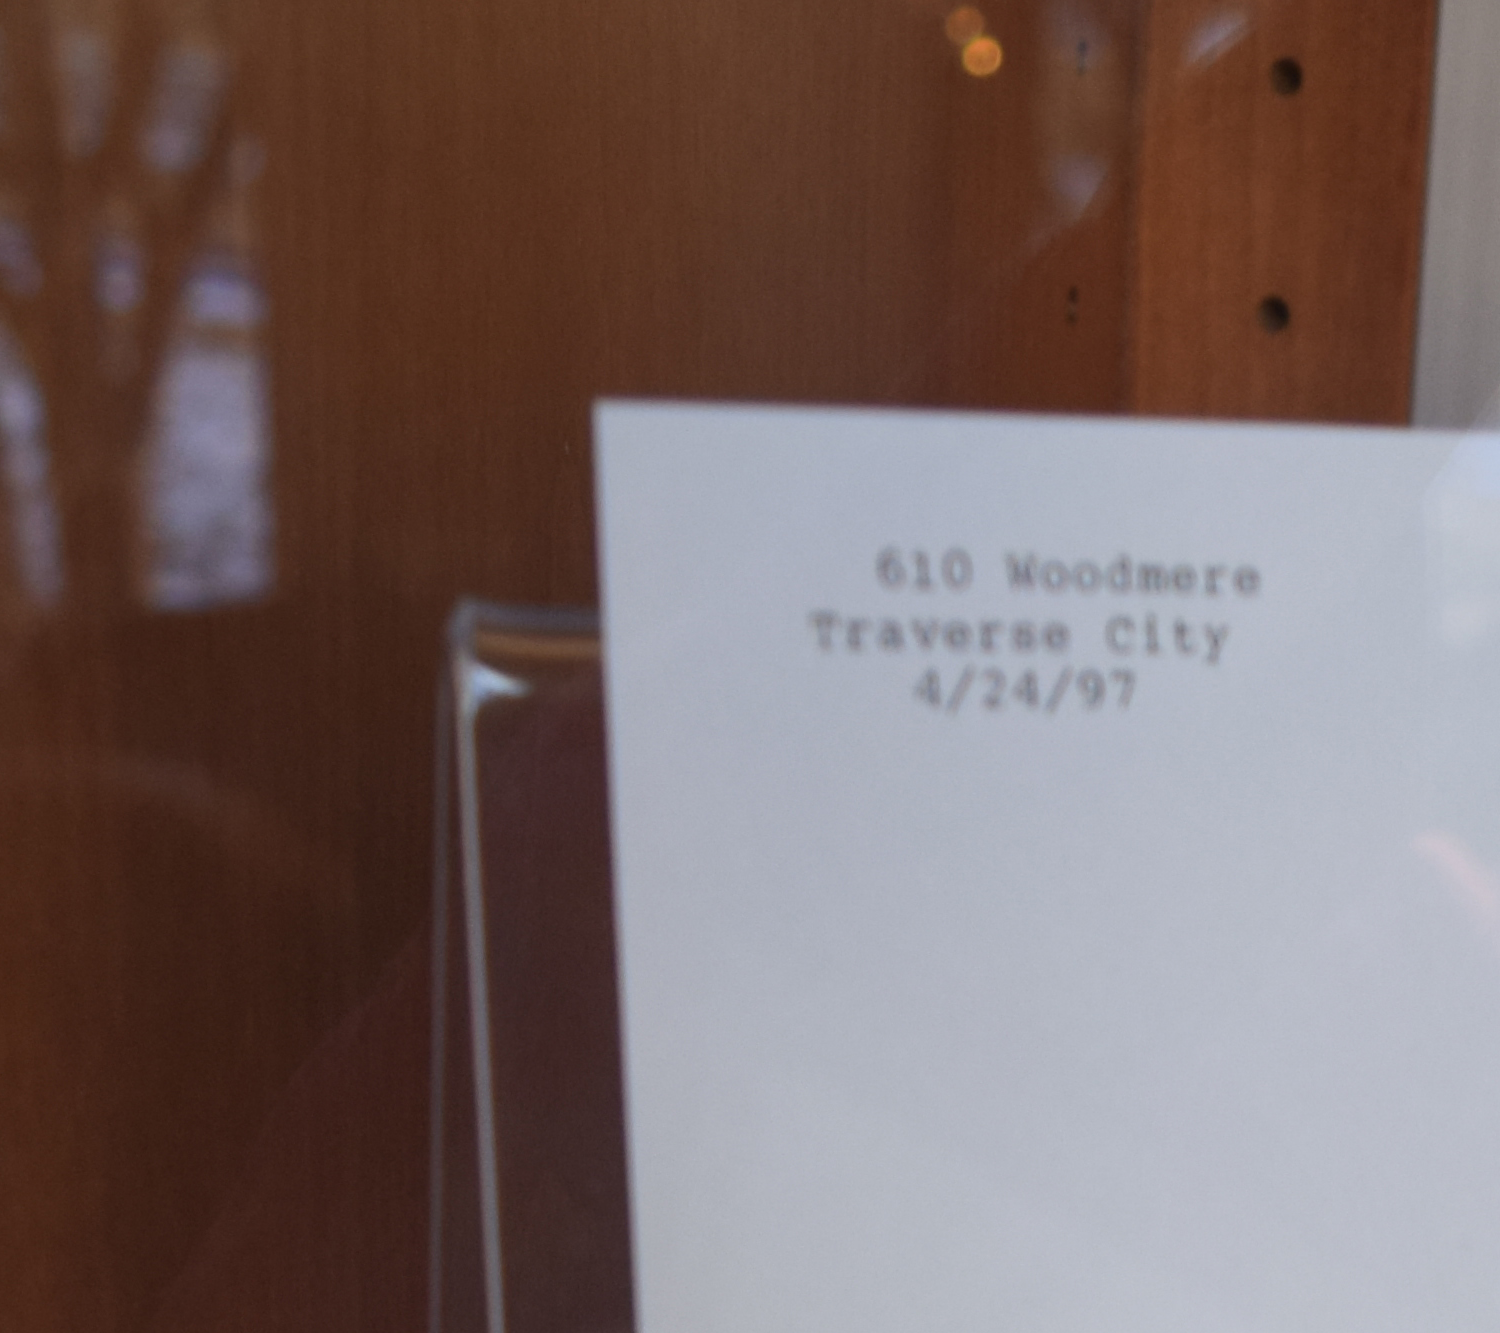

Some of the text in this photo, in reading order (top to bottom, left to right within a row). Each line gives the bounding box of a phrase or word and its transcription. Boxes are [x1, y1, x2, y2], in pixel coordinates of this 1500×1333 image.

[874, 548, 1264, 600] 610 Woodmere
[808, 611, 1233, 664] Traverse City
[911, 668, 1138, 714] 4/24/97
